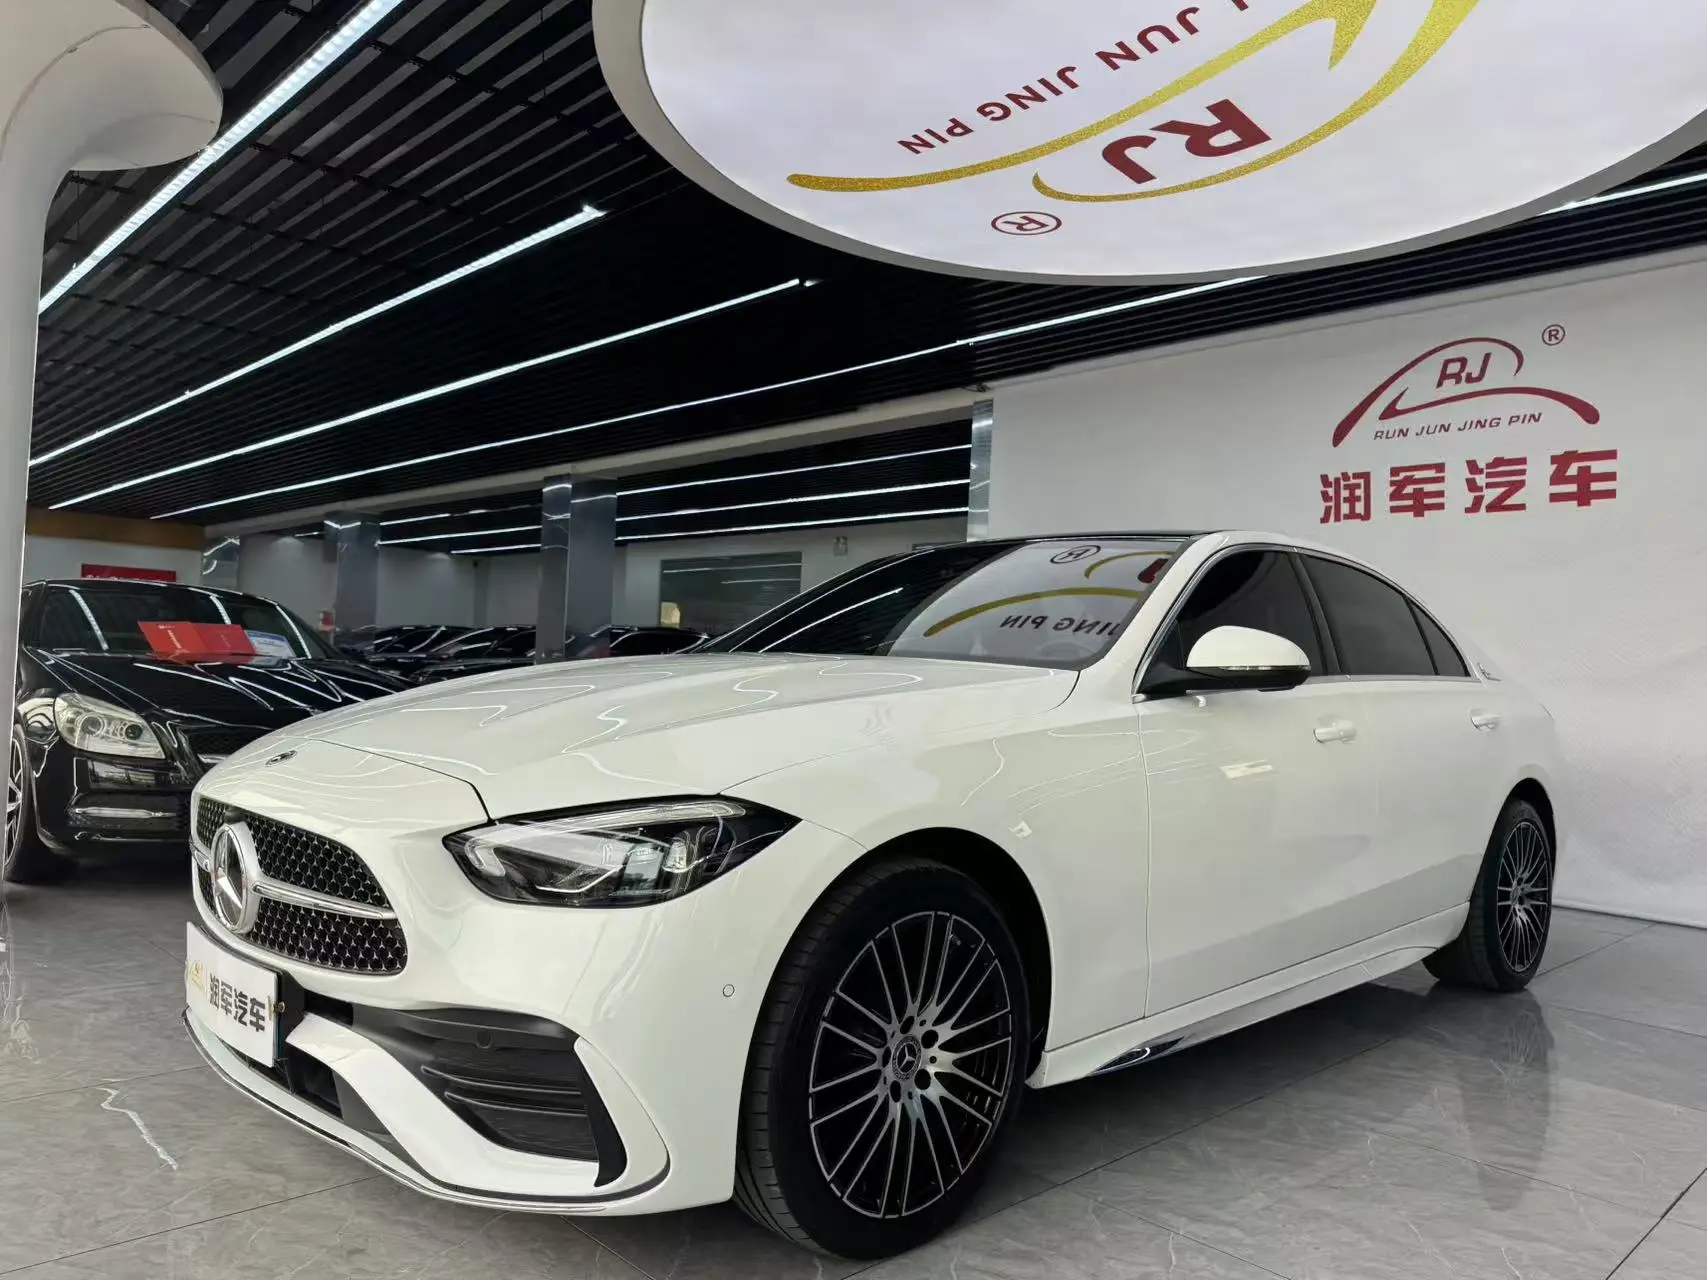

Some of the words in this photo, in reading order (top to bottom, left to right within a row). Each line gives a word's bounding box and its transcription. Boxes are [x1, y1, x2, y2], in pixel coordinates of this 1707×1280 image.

[1095, 7, 1200, 71] JUN
[976, 66, 1079, 122] JING
[897, 117, 974, 155] PIN
[1102, 99, 1272, 184] RJ
[1436, 352, 1492, 388] RJ
[1373, 427, 1409, 440] RUN
[1416, 423, 1451, 436] JUN
[1458, 417, 1501, 432] JING
[1508, 412, 1542, 426] PIN
[1320, 449, 1618, 524] 润军汽车
